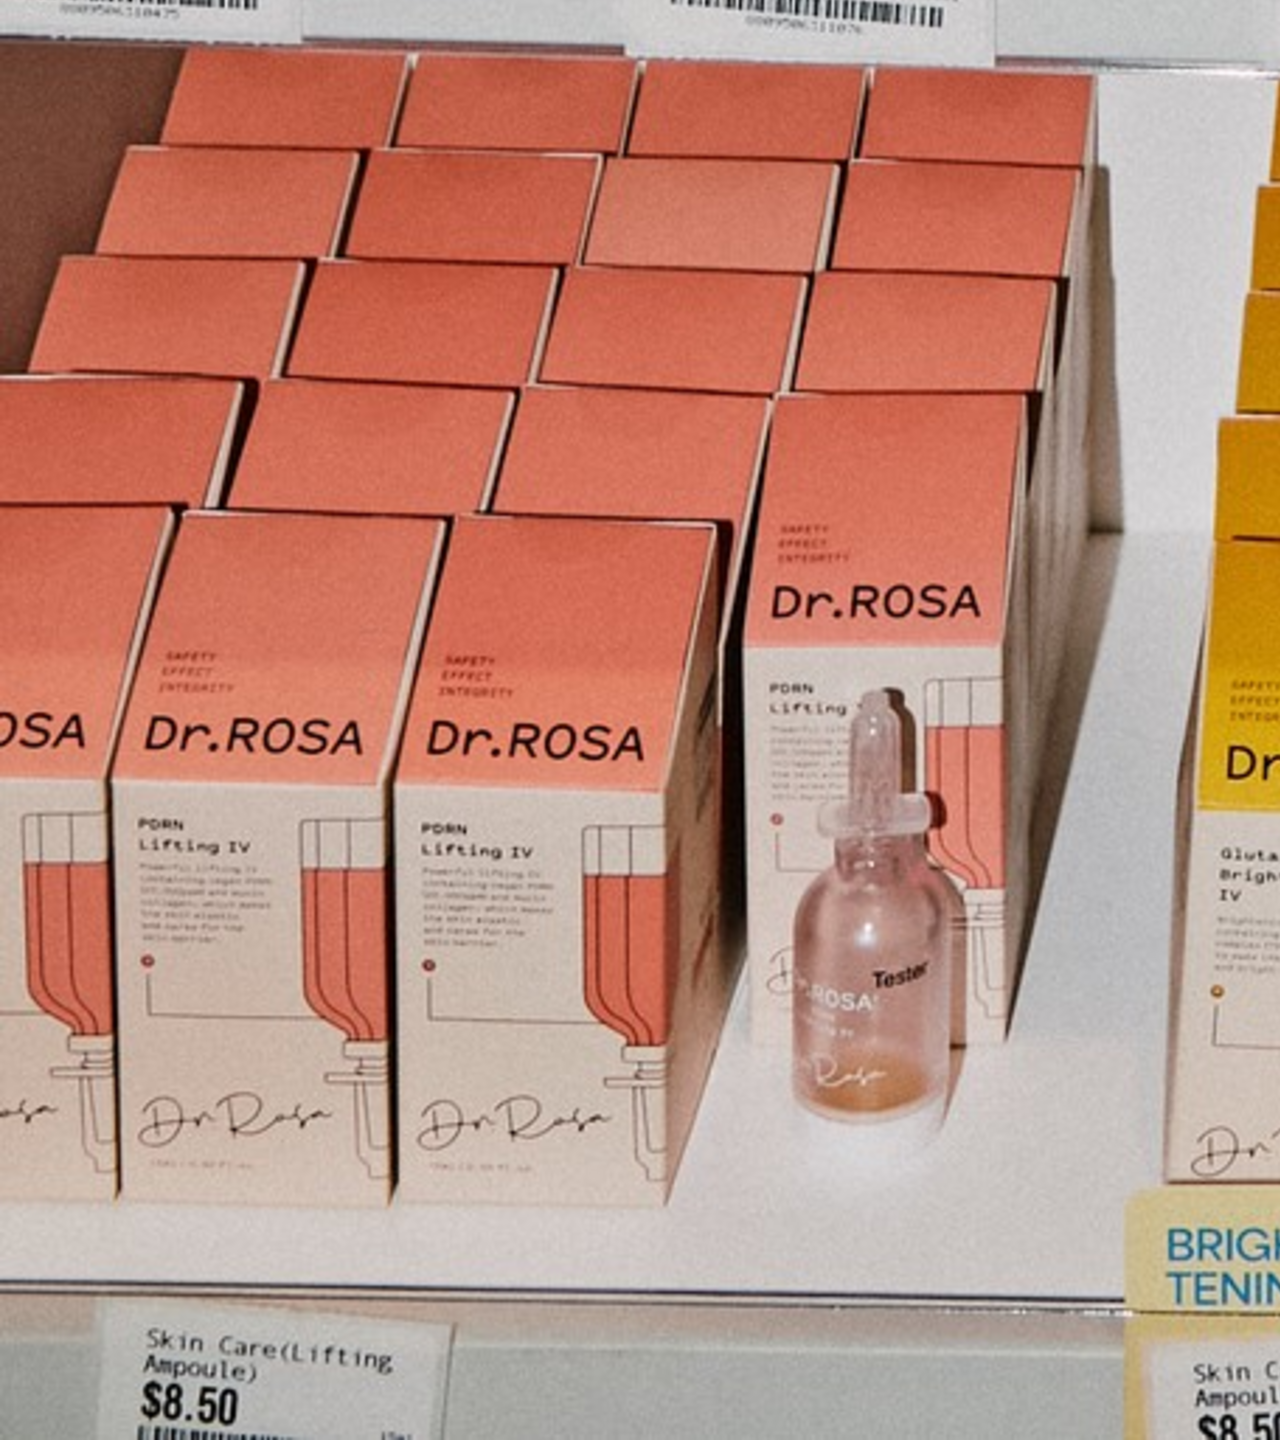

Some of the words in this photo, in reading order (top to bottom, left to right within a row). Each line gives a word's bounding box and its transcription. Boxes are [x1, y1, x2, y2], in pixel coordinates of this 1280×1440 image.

[770, 582, 982, 620] Dr.ROSA
[144, 714, 364, 757] Dr.ROSA
[425, 719, 646, 762] Dr.ROSA
[138, 837, 220, 855] Lifting
[227, 839, 251, 854] IV
[143, 1354, 258, 1385] Ampoule)
[146, 1328, 204, 1353] Skin
[218, 1335, 394, 1376] Care(Lifting
[1193, 1363, 1251, 1383] Skin
[140, 1380, 239, 1427] $8.50
